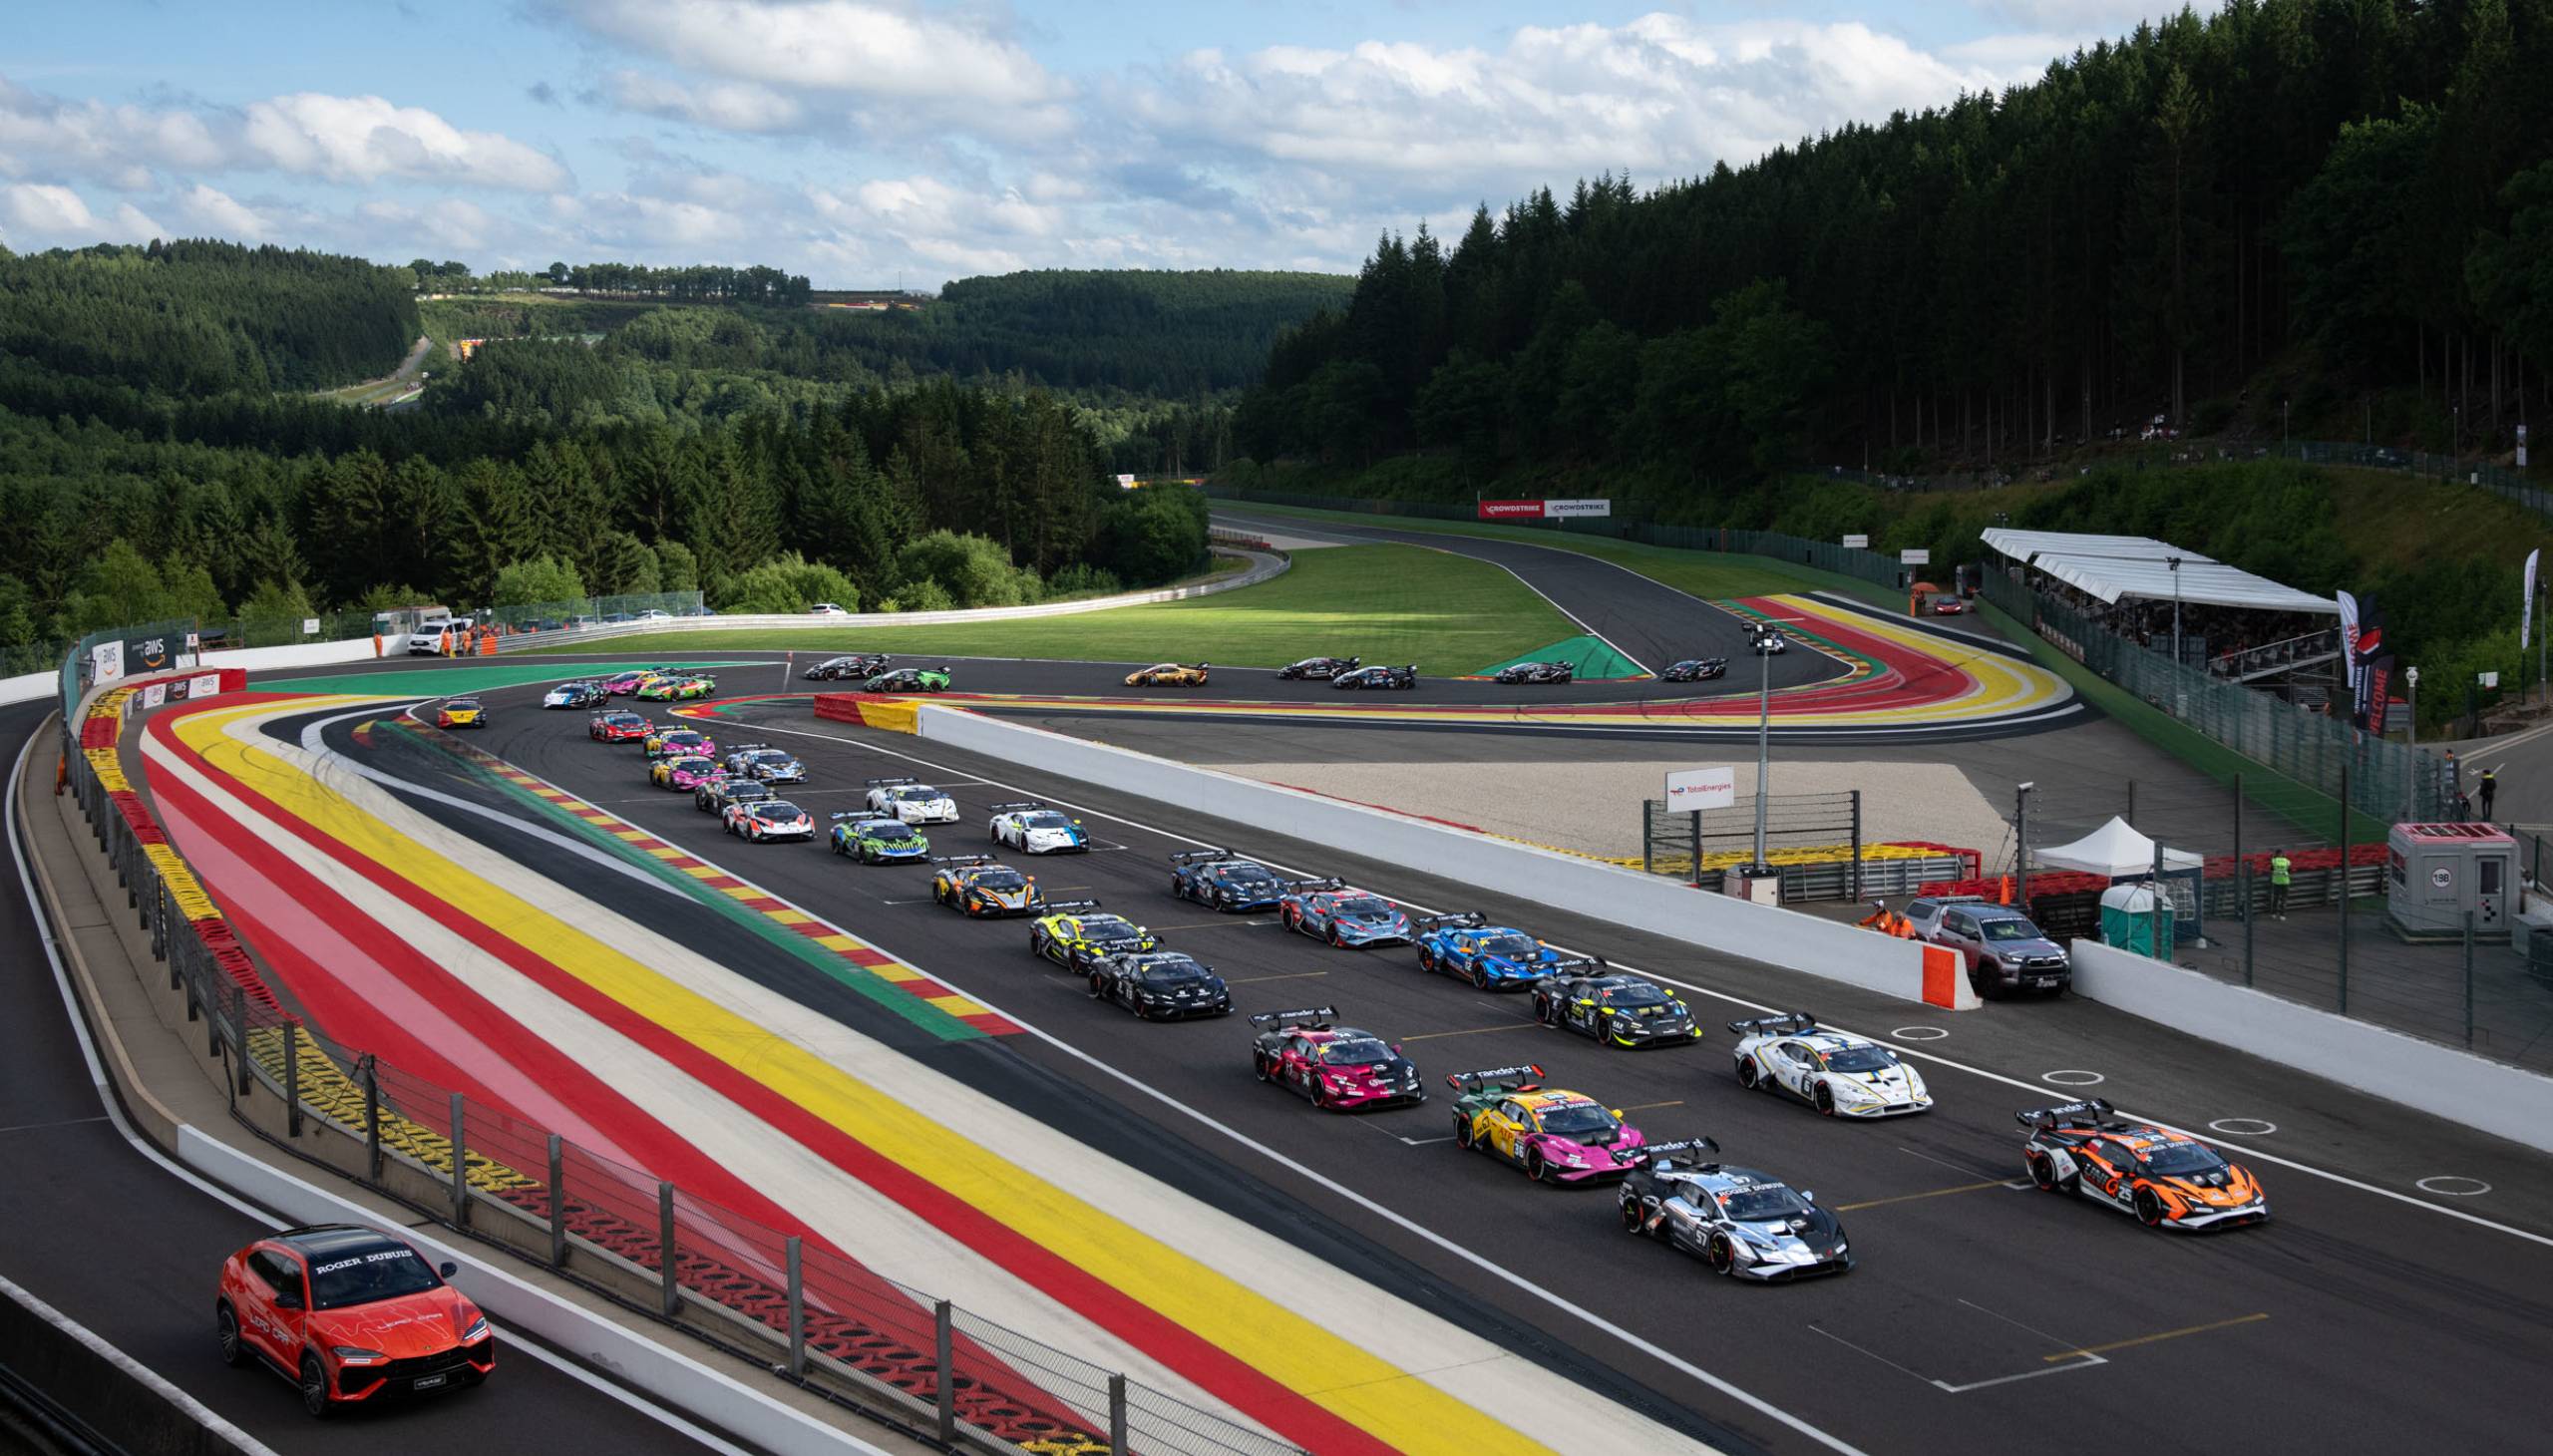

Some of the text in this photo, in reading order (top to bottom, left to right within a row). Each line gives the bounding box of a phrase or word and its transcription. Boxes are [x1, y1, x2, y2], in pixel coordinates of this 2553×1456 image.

[103, 647, 116, 663] aws
[145, 638, 165, 655] aws
[1687, 783, 1731, 793] TotalEnergies
[2433, 874, 2449, 883] 198
[2118, 1185, 2133, 1203] 25
[1695, 1229, 1708, 1248] 57
[315, 1250, 413, 1274] ROGER DUBUIS
